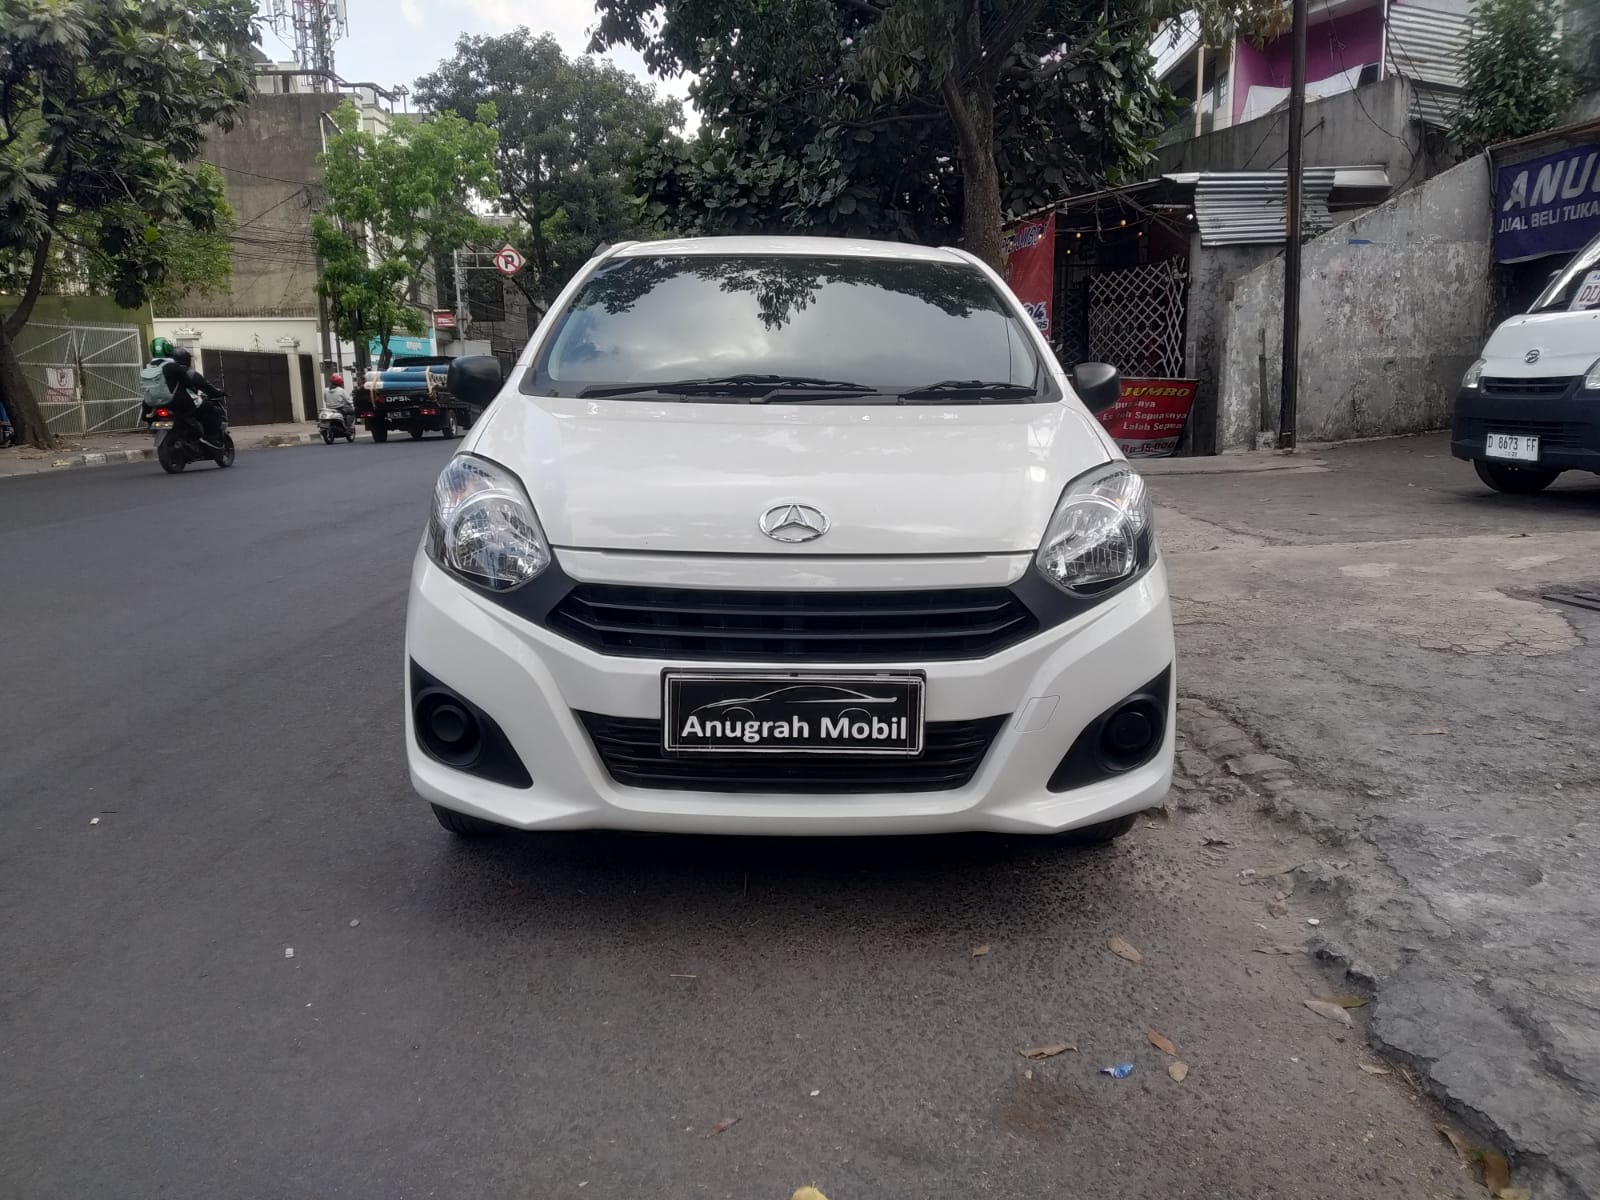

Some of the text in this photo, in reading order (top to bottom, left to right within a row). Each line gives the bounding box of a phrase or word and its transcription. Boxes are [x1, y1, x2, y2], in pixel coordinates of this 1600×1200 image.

[1498, 201, 1600, 233] JUAL BELI TUKA
[1121, 387, 1190, 397] JUMBO
[1488, 436, 1536, 453] D 8673 FF
[682, 715, 907, 743] Anugrah Mobil
